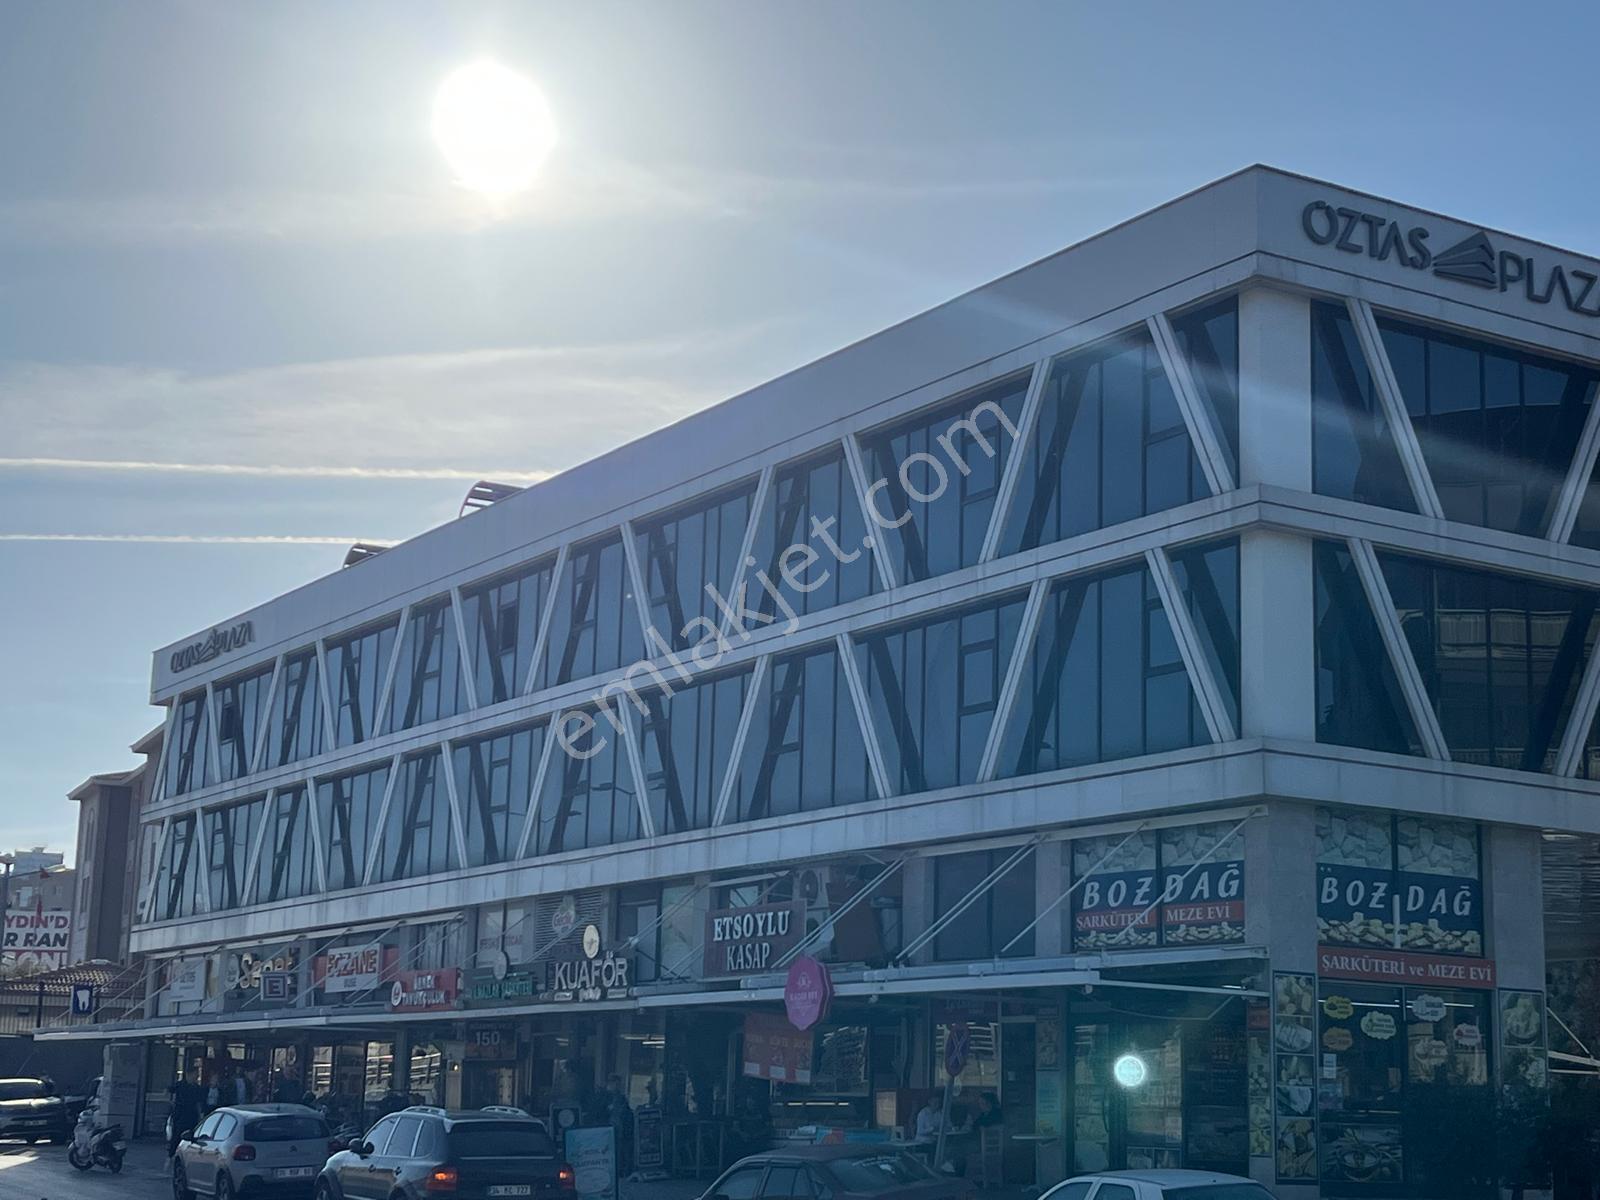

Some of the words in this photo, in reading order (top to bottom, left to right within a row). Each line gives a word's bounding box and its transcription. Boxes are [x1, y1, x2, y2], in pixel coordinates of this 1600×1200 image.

[713, 910, 791, 942] ETSOYLU
[1166, 906, 1203, 922] MEZE
[1207, 902, 1230, 920] EVİ
[327, 949, 377, 977] ECZANE
[554, 951, 628, 990] KUAFÖR
[726, 942, 771, 972] KASAP
[1321, 953, 1405, 976] ŞARKÜTERİ
[1409, 965, 1425, 976] ve
[1428, 964, 1466, 979] MEZE
[1469, 965, 1492, 981] EVİ
